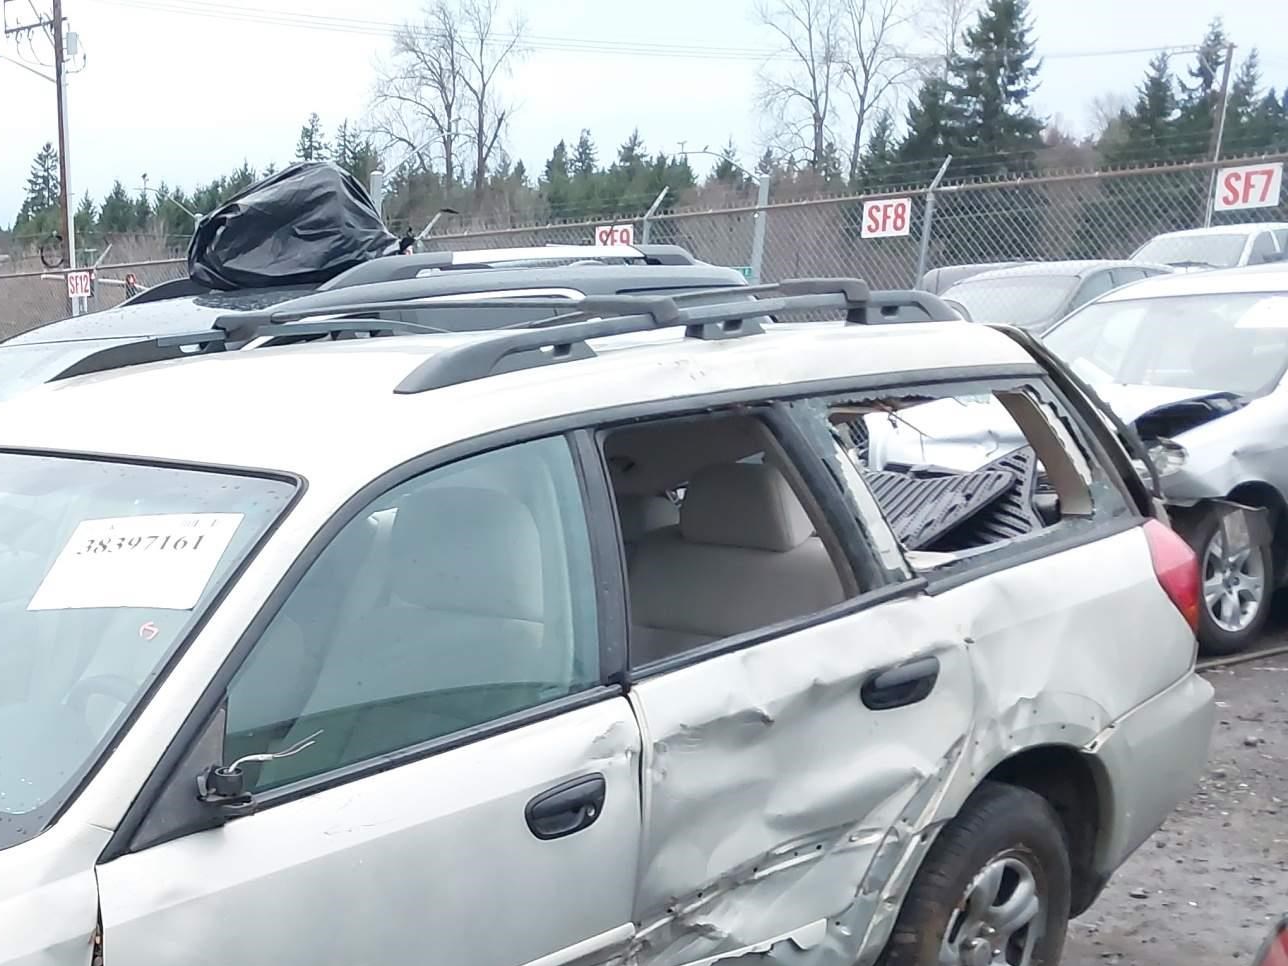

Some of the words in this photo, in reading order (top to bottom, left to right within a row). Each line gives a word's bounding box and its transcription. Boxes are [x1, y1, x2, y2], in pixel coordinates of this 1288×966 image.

[1222, 168, 1275, 206] SF7
[866, 202, 907, 234] SF8
[68, 273, 90, 295] SF12
[76, 534, 205, 555] 38397161
